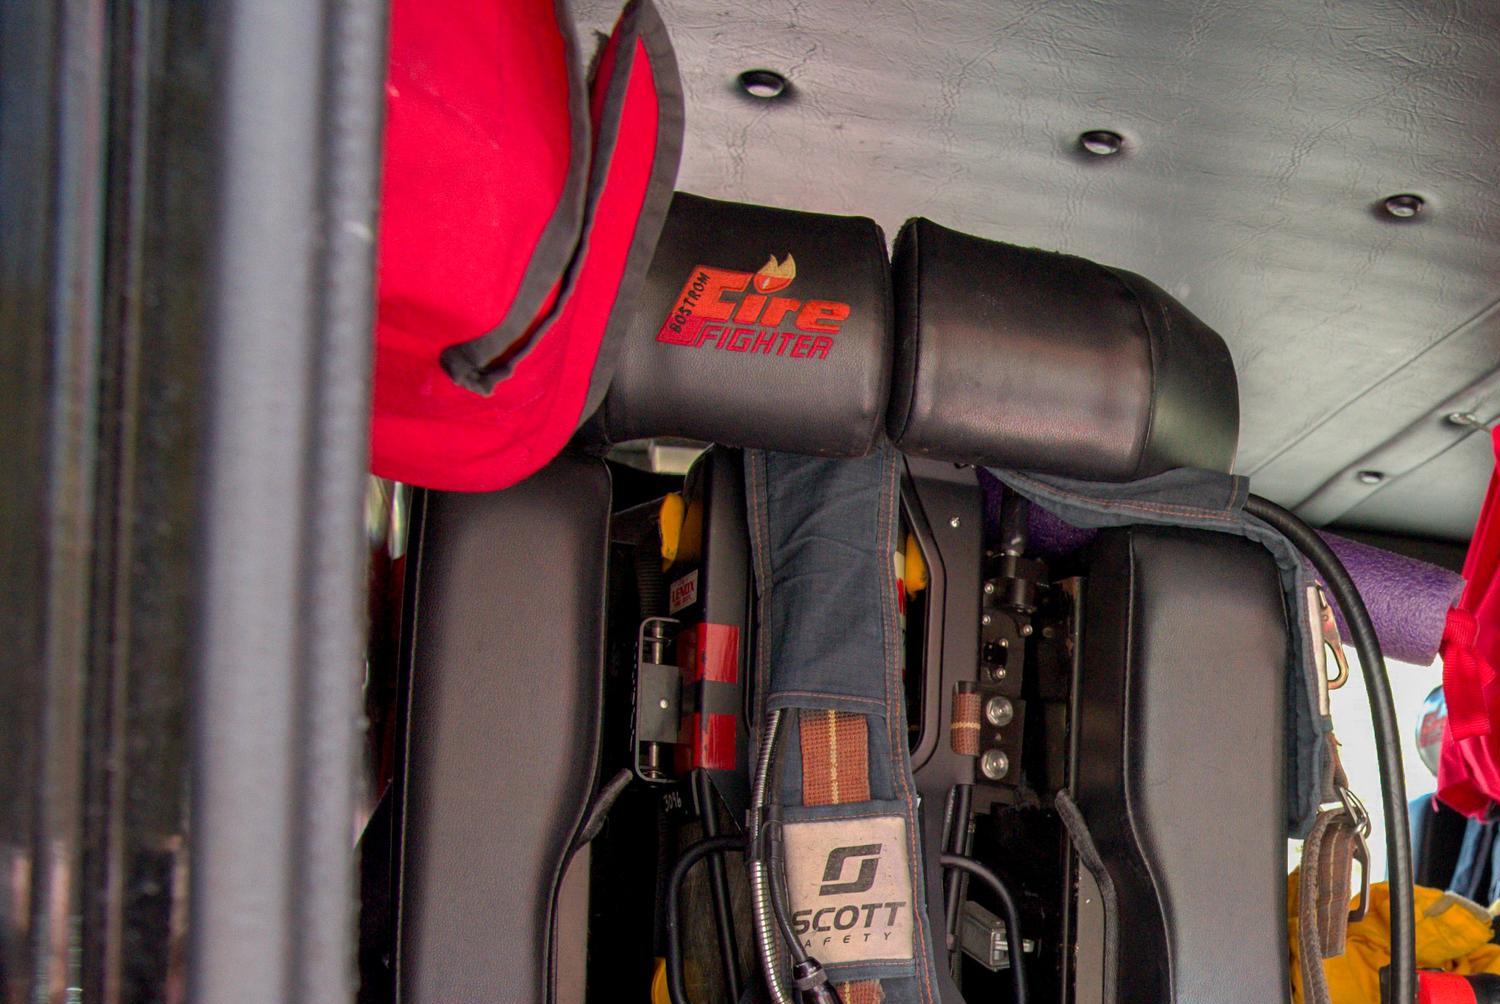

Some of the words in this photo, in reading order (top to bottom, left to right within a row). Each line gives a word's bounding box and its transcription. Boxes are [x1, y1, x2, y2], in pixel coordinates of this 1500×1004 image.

[669, 271, 711, 335] BOSTROM
[695, 324, 834, 360] FIGHTER
[791, 901, 907, 936] SCOTT
[803, 931, 892, 948] AFETY
